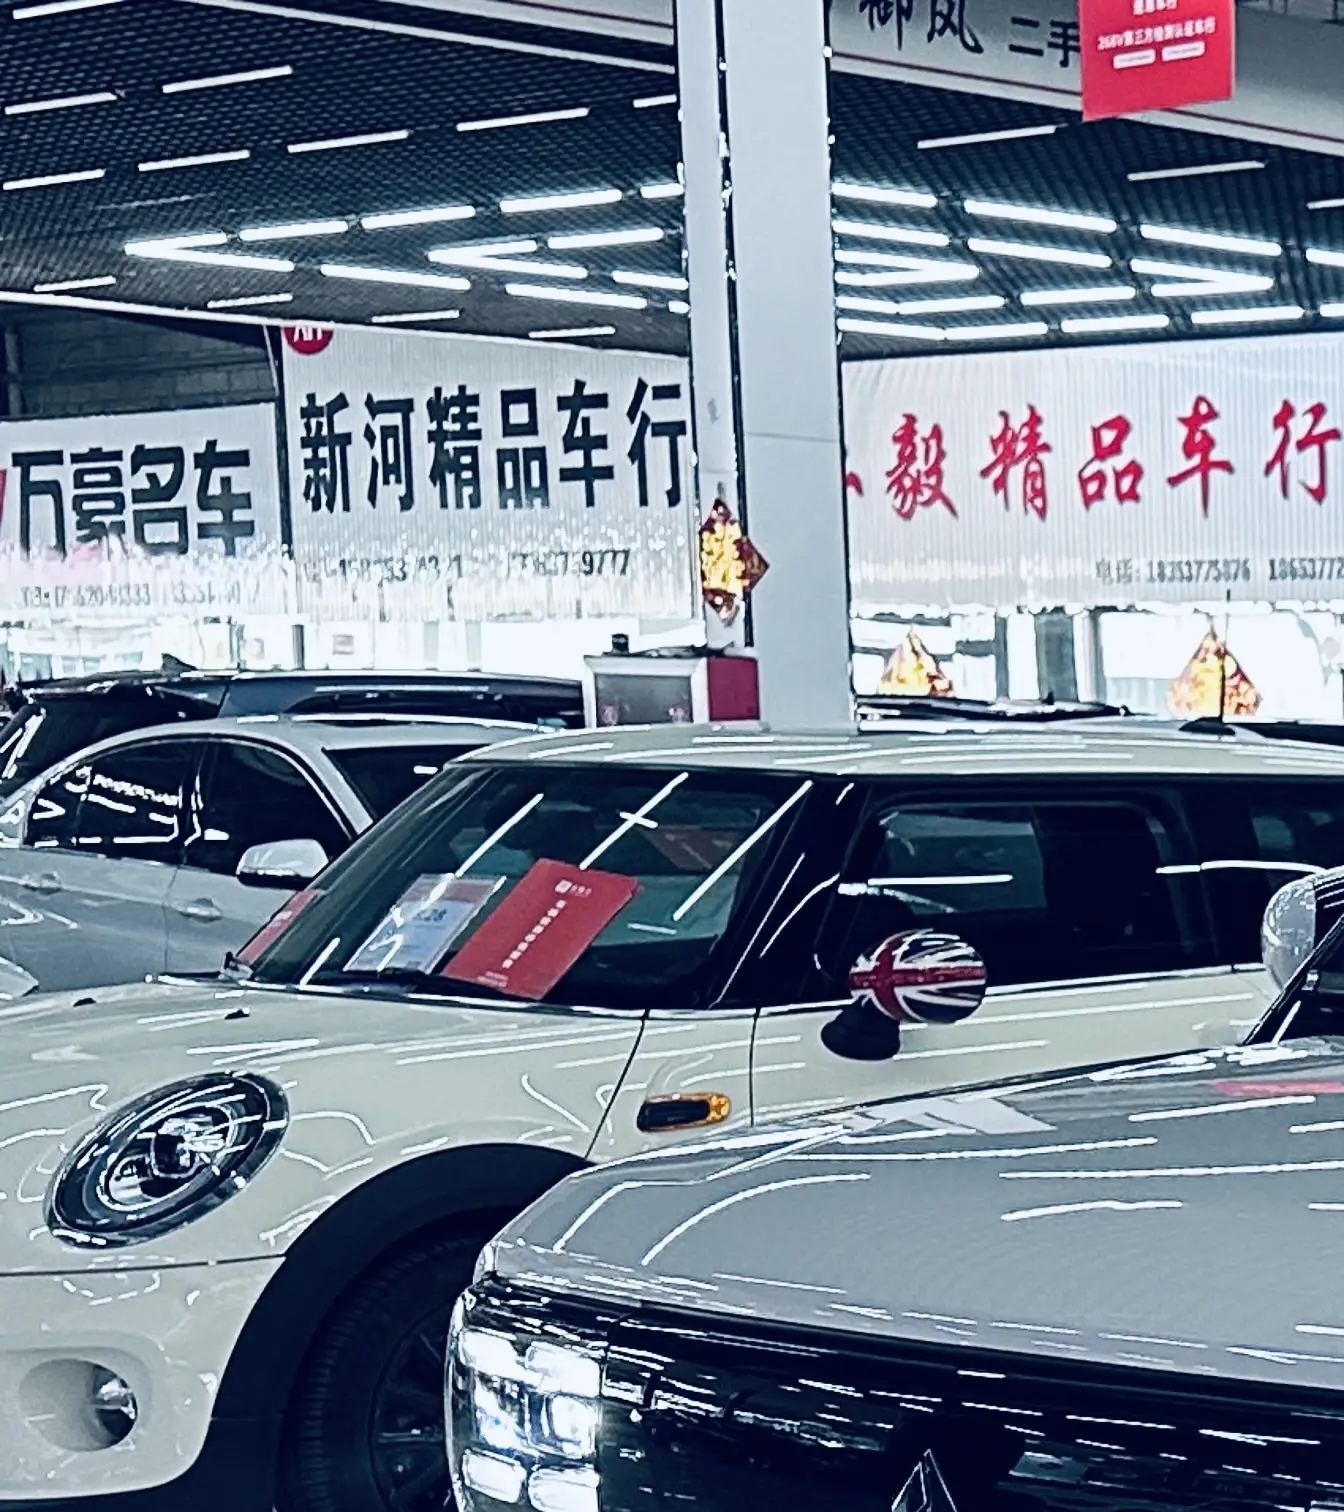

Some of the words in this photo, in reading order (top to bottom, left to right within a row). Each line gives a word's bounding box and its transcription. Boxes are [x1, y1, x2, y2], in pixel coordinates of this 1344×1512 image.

[12, 439, 255, 562] 万豪名车
[300, 377, 687, 513] 新河精品车行
[844, 395, 1342, 520] 毅精品车行
